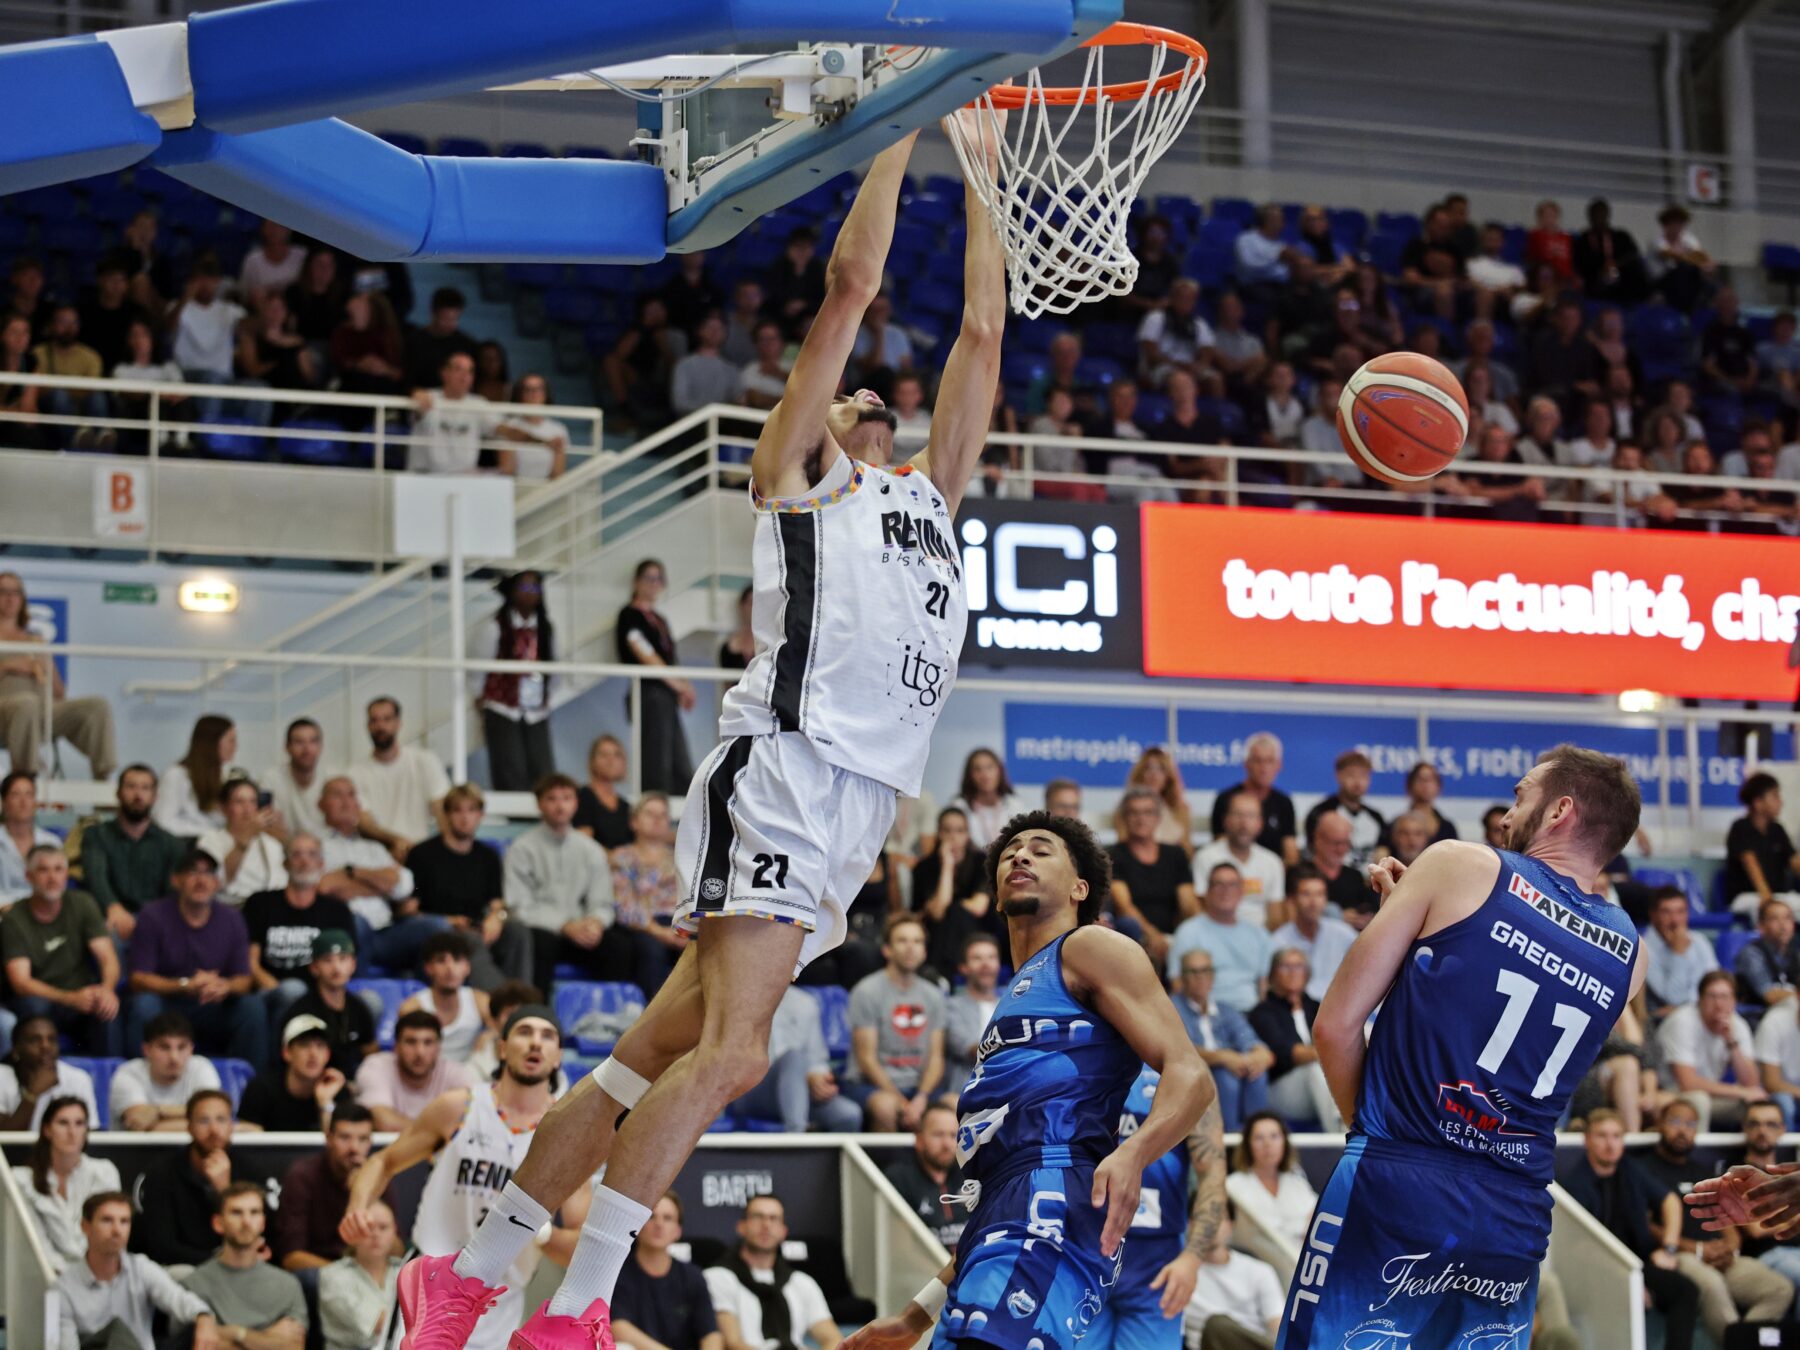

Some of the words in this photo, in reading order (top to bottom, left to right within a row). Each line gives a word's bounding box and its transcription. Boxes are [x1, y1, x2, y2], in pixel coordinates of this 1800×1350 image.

[110, 473, 135, 514] B
[1222, 558, 1394, 625] toute
[1401, 560, 1705, 651] l'actualité,
[1511, 874, 1632, 961] MAYENNE
[1490, 920, 1615, 1011] GREGOIRE
[1476, 968, 1592, 1100] 11
[1290, 1211, 1344, 1322] USL
